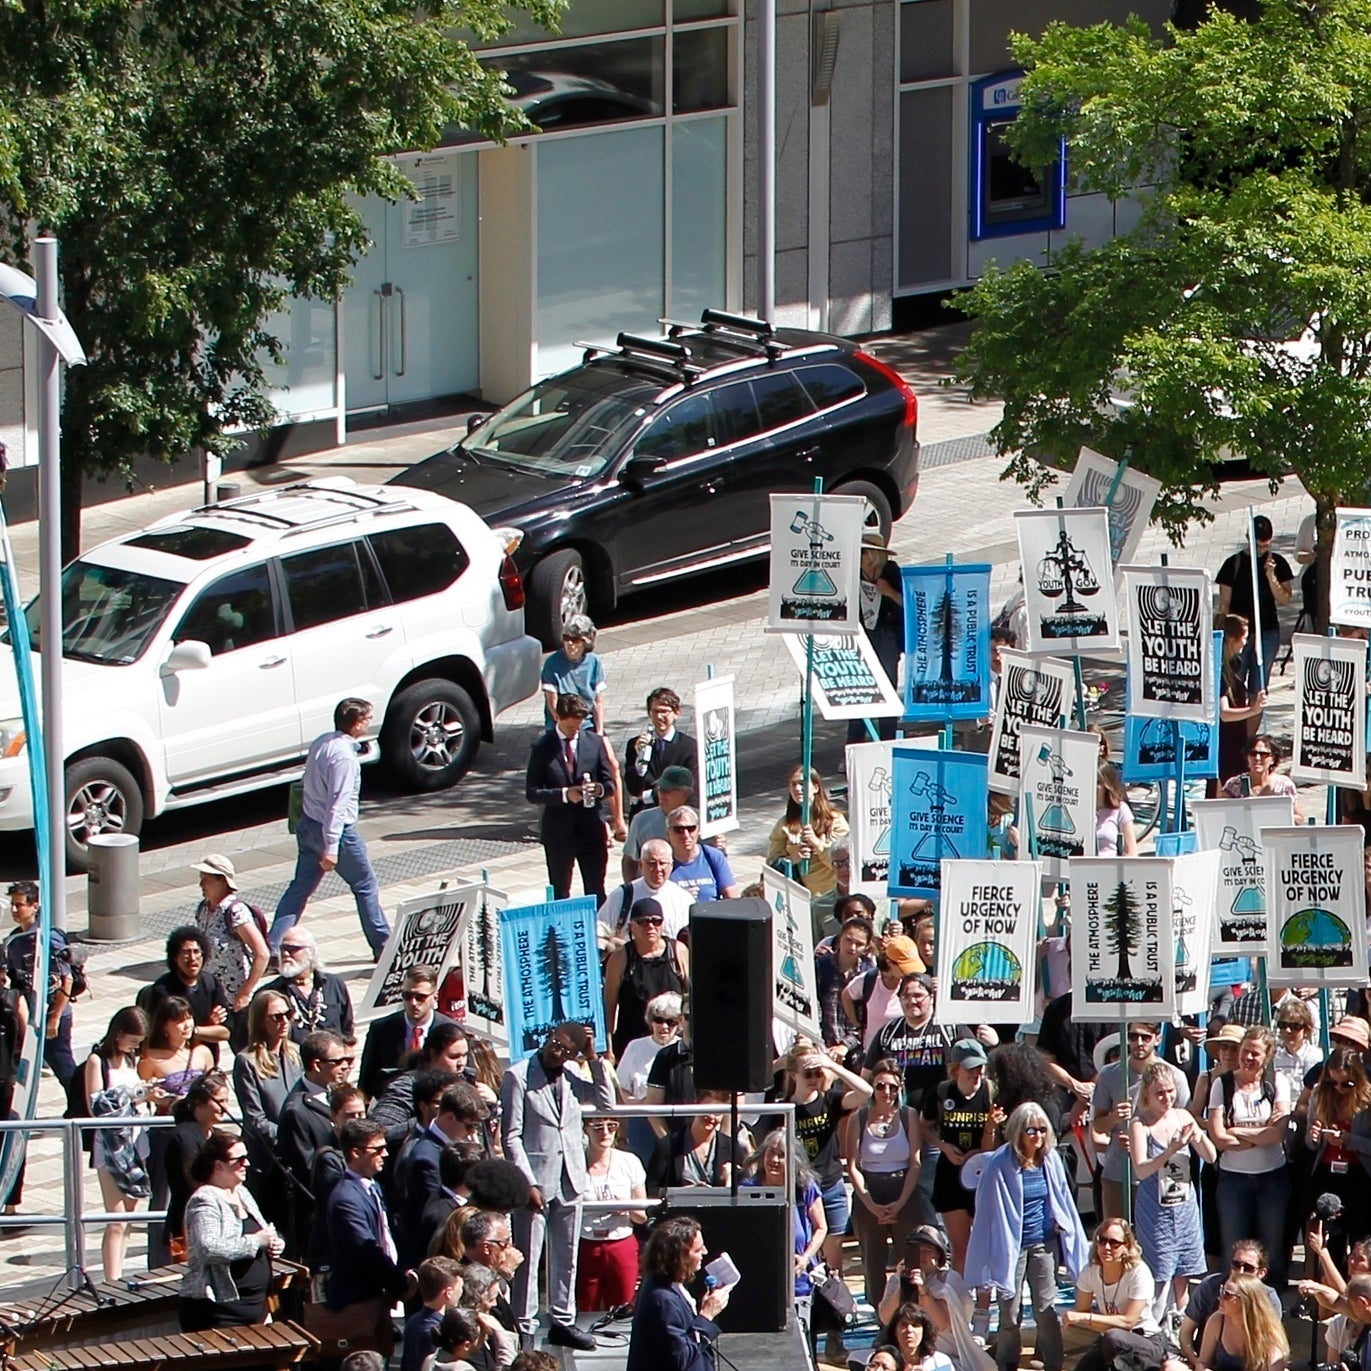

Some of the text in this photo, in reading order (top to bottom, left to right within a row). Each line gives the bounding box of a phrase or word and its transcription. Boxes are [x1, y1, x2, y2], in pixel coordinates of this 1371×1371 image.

[790, 549, 841, 560] GIVE SCIENCE
[1038, 579, 1096, 589] YOUTH GOV
[917, 590, 927, 674] THE ATMOSPHERE
[966, 589, 978, 675] IS A PUBLIC TRUST
[1147, 621, 1194, 638] LET THE
[813, 650, 859, 663] LET THE
[1144, 638, 1199, 660] YOUTH
[817, 661, 868, 677] YOUTH
[1145, 659, 1200, 675] BE HEARD
[820, 675, 876, 691] BE HEARD
[1308, 690, 1348, 708] LET THE
[1305, 706, 1350, 729] YOUTH
[1303, 726, 1352, 746] BE HEARD
[910, 812, 964, 826] GIVE SCIENCE
[918, 824, 934, 832] DAY
[942, 824, 964, 833] COURT
[1291, 852, 1334, 869] FIERCE
[1281, 868, 1344, 885] URGENCY
[972, 885, 1014, 901] FIERCE
[1286, 885, 1340, 901] OF NOW
[960, 901, 1022, 919] URGENCY
[963, 918, 1015, 934] OF NOW
[1087, 882, 1100, 972] THE ATMOSPHERE
[1146, 882, 1159, 973] IS A PUBLIC TRUST
[574, 920, 590, 1009] IS A PUBLIC TRUST
[519, 930, 535, 1020] THE ATMOSPHERE
